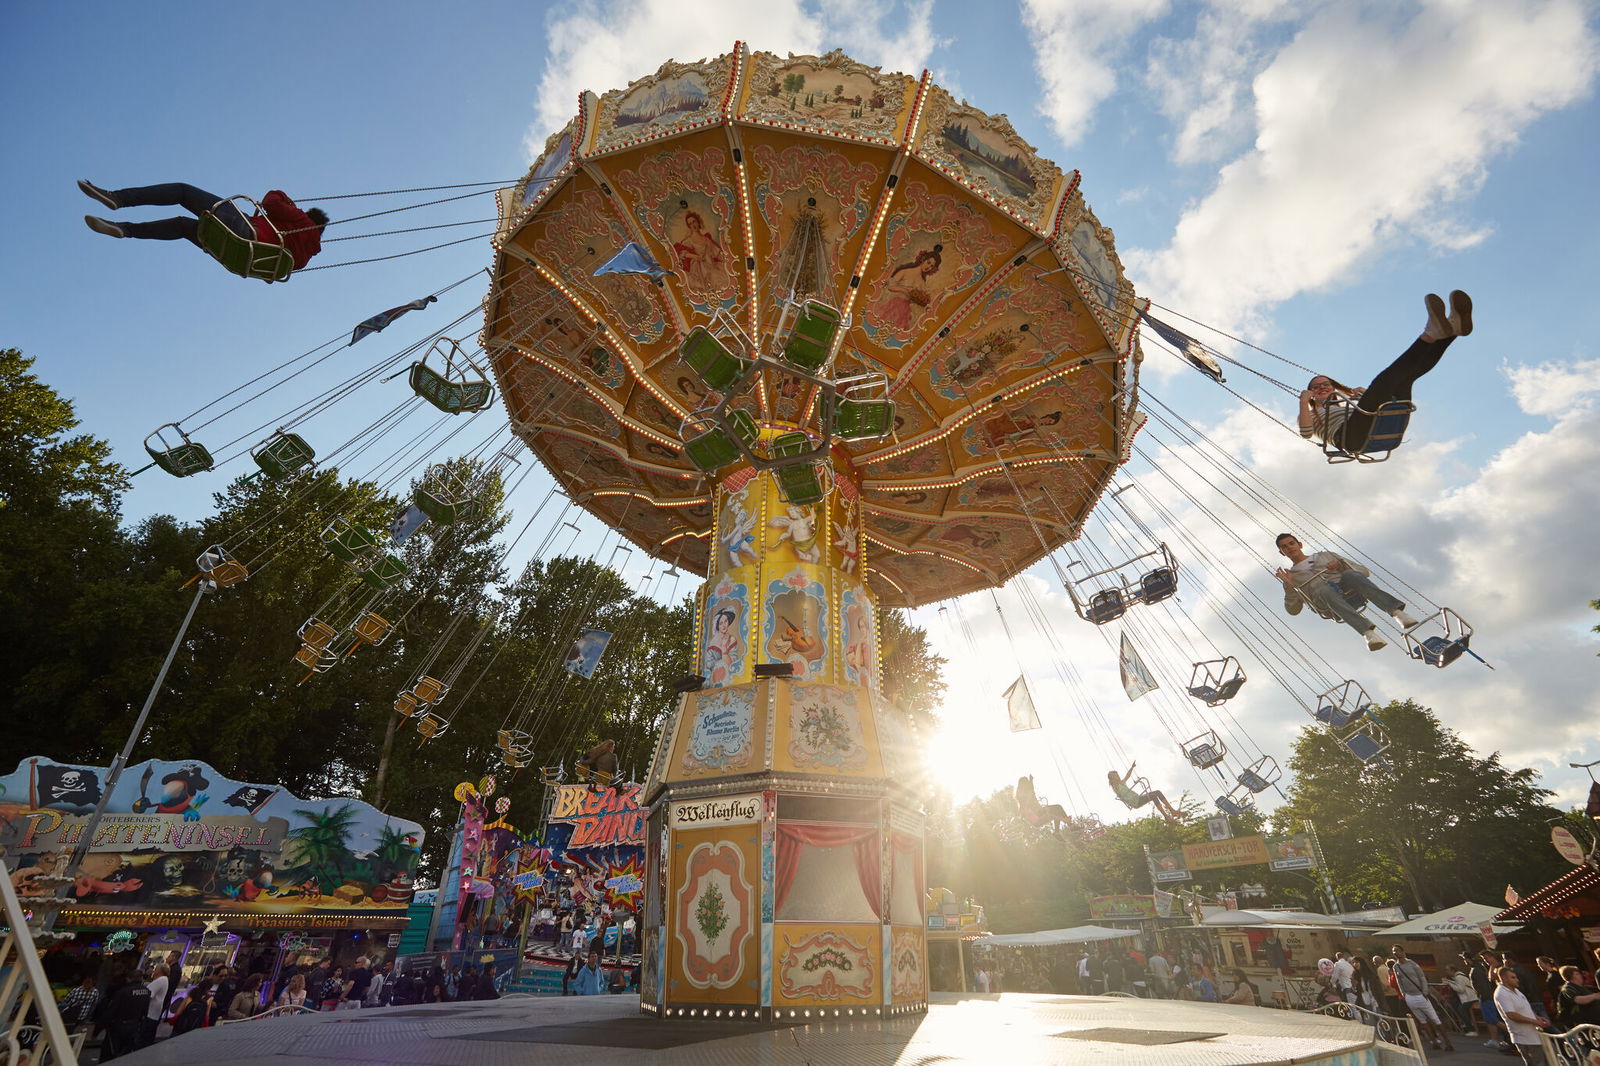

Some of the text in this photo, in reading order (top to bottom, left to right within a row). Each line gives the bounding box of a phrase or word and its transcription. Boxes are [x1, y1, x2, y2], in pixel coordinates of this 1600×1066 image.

[554, 785, 641, 818] BREAK
[676, 798, 761, 822] Wellenflug
[64, 911, 190, 927] Treasure Island
[246, 916, 349, 929] Treasure Island
